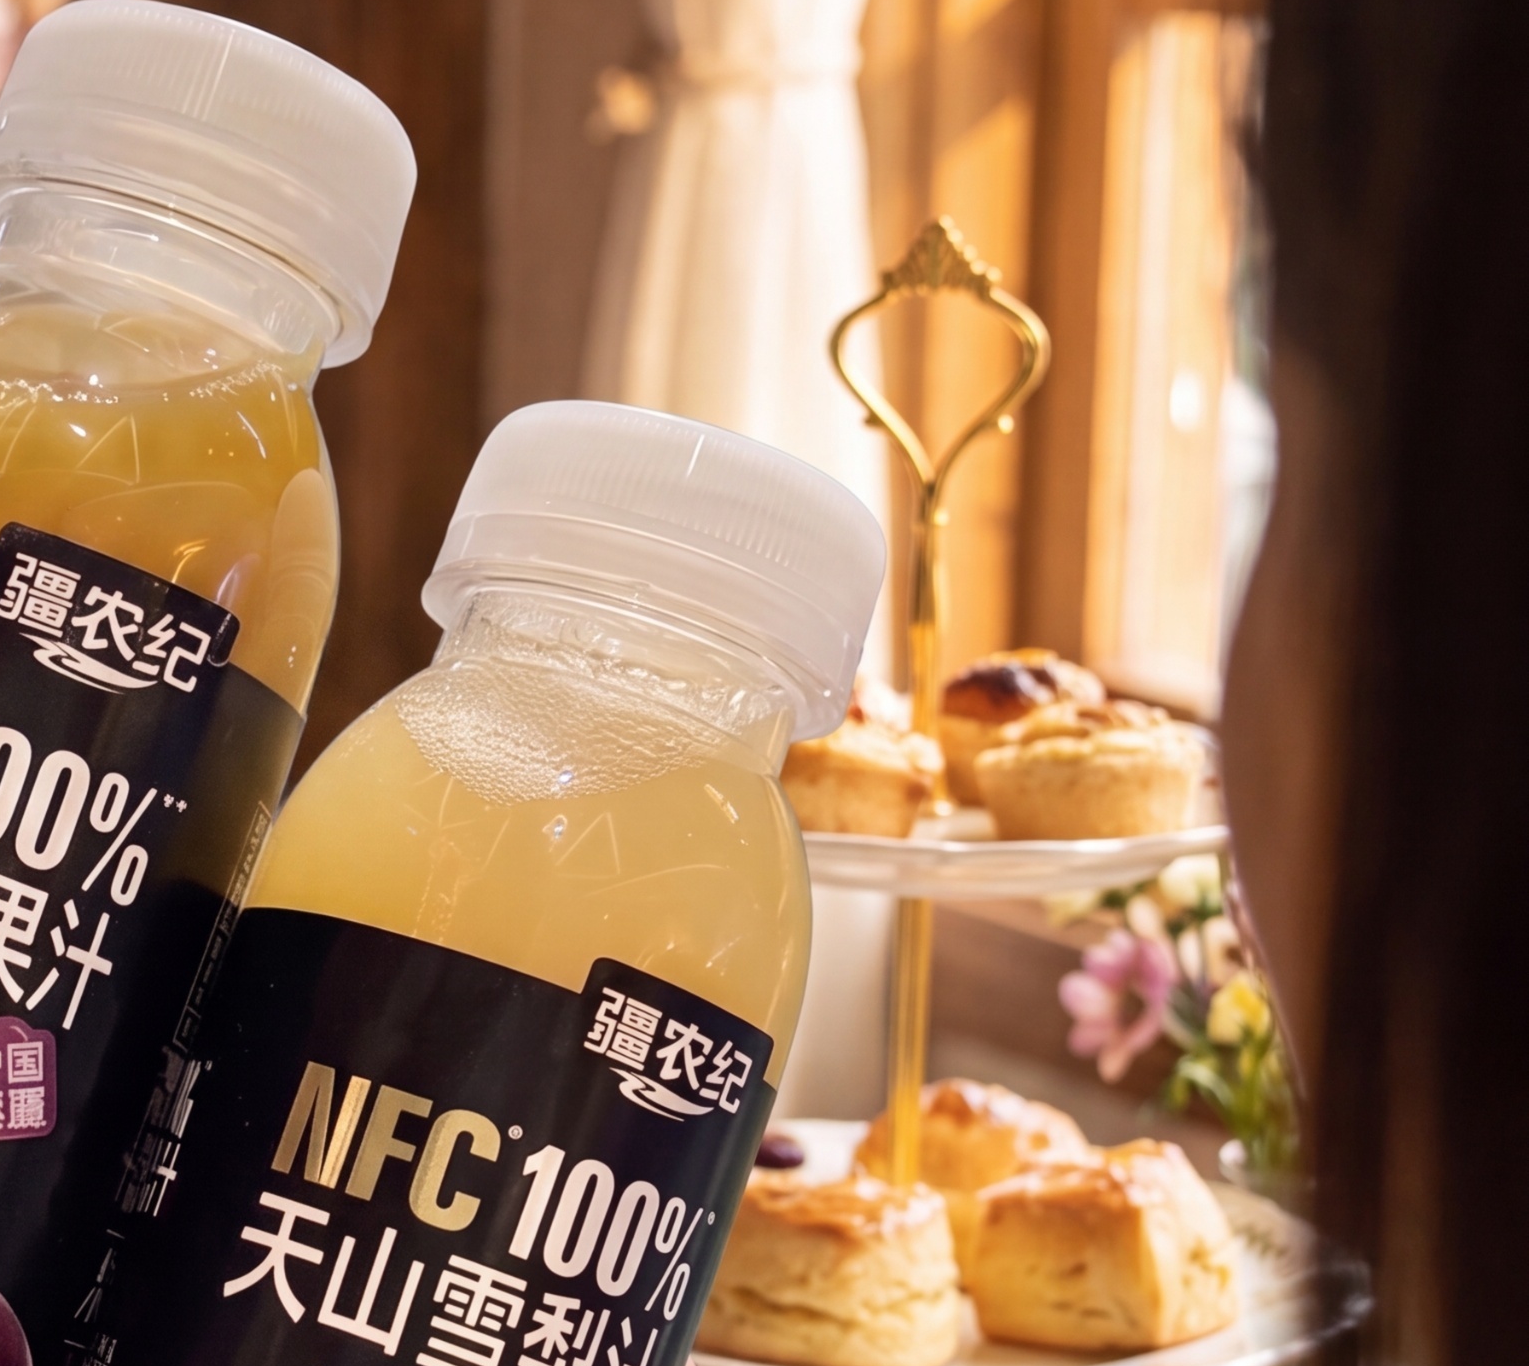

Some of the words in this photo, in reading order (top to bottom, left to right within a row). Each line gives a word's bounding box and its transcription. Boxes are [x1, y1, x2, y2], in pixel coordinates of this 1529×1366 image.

[584, 987, 754, 1115] 疆农纪
[270, 1060, 502, 1233] NFC
[508, 1145, 704, 1321] 100%
